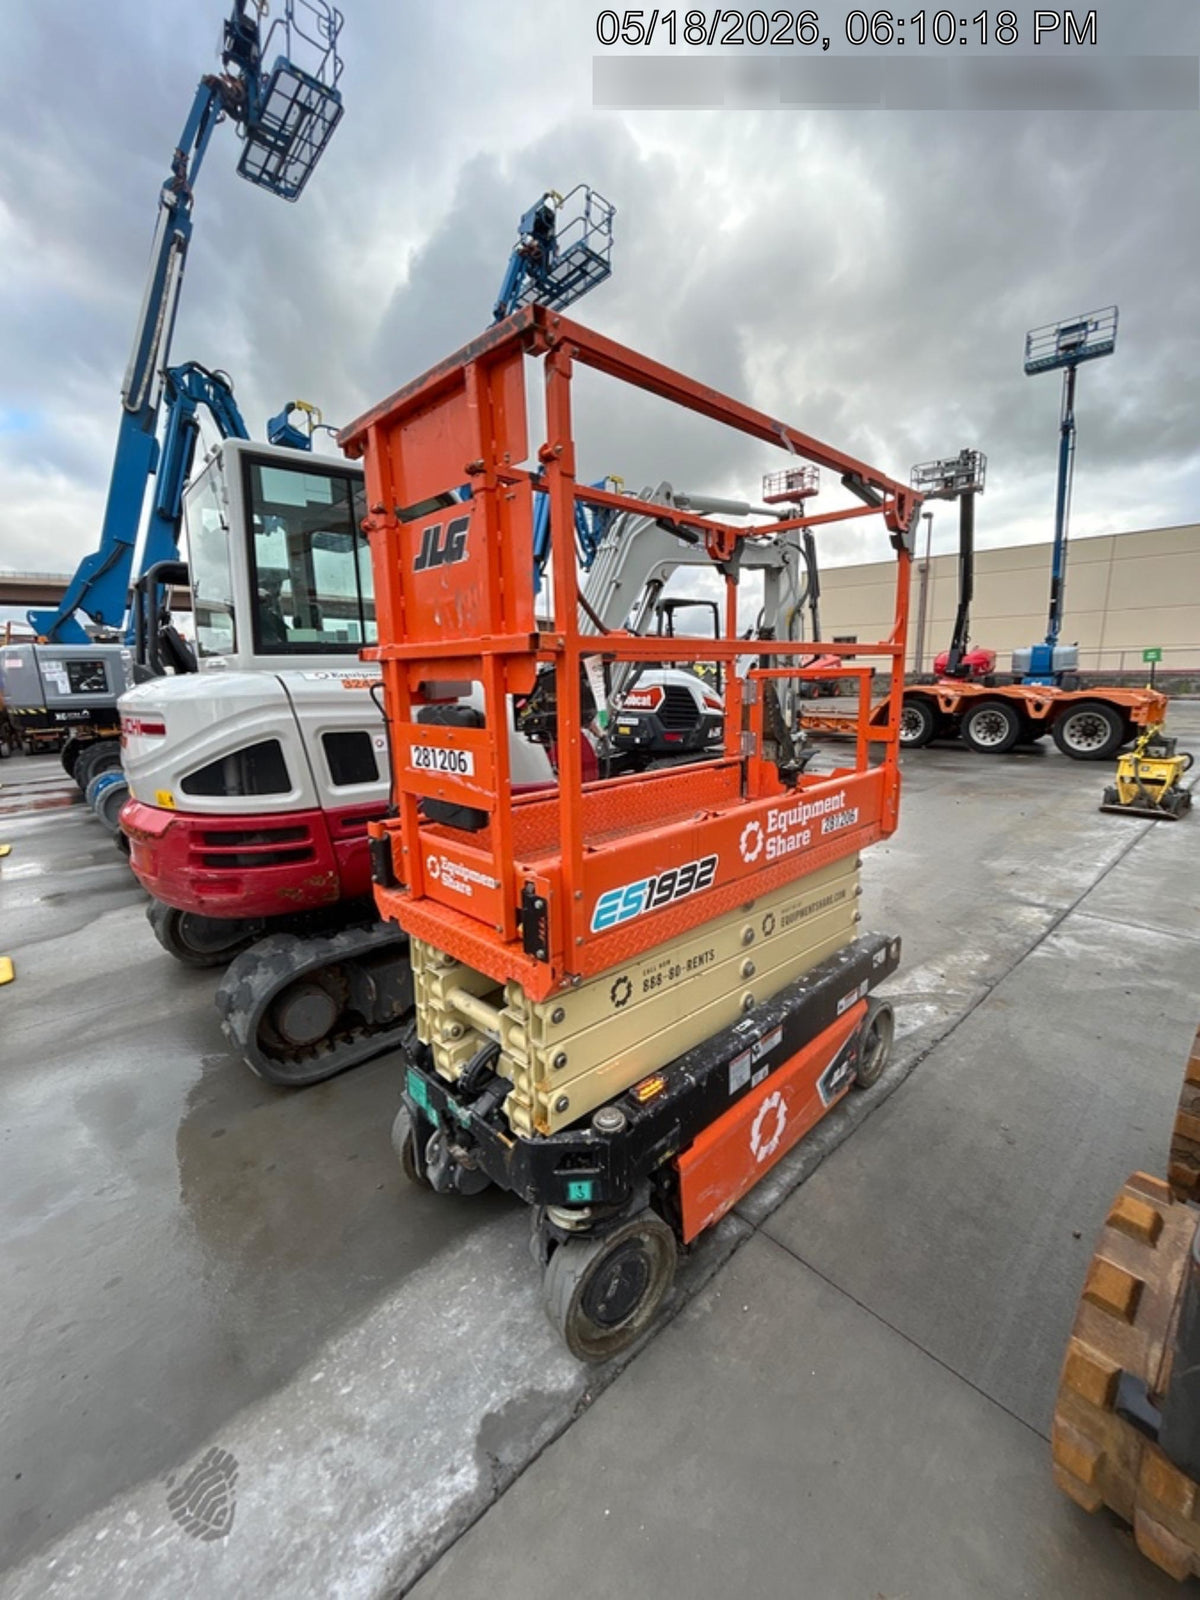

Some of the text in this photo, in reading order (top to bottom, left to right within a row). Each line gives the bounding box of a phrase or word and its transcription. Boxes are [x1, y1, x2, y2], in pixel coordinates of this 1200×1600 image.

[413, 514, 470, 573] JLG
[413, 746, 468, 773] 281206
[766, 790, 846, 833] Equipment
[766, 829, 811, 860] Share
[439, 856, 500, 890] Equipmen
[441, 872, 473, 896] Share
[591, 854, 719, 933] ES1932
